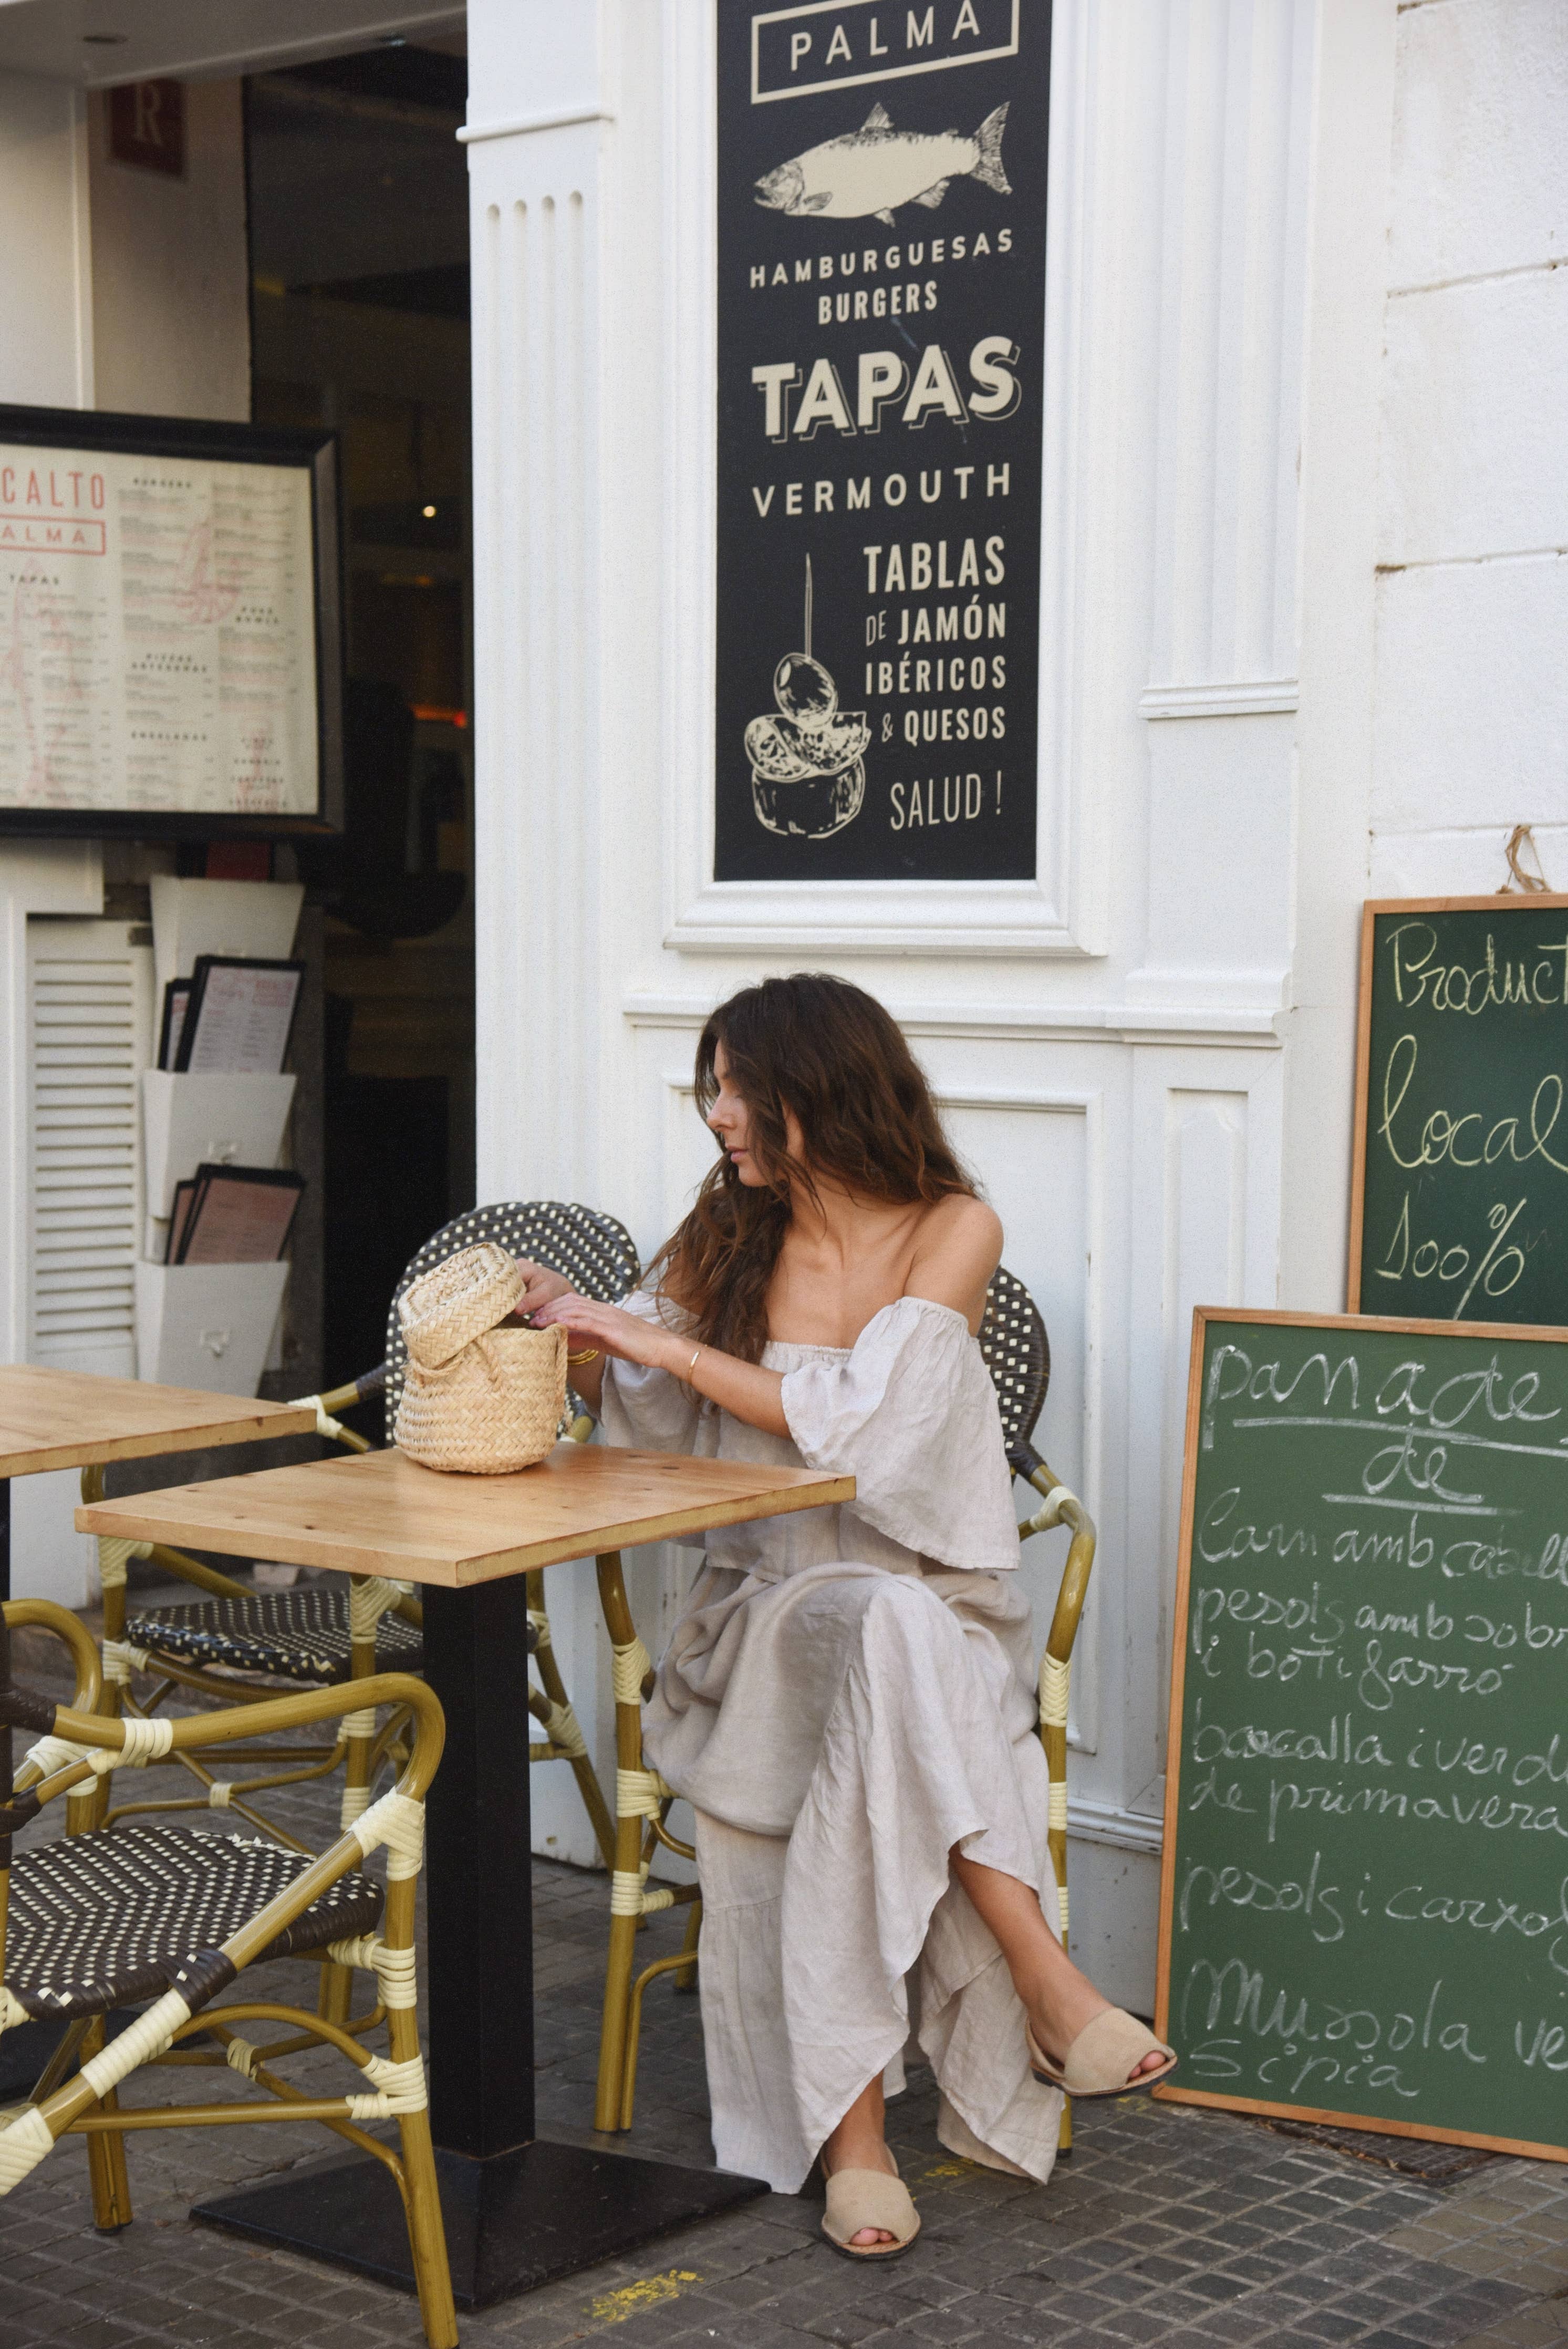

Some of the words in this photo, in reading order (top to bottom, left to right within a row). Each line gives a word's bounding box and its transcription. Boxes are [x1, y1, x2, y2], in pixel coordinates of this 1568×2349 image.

[791, 0, 982, 71] PALMA
[750, 228, 1012, 288] HAMBURGUESAS
[818, 276, 937, 325] BURGERS
[751, 334, 1021, 444] TAPAS
[2, 466, 105, 510] CALTO
[752, 463, 1010, 517] VERMOUTH
[863, 535, 1005, 594] TABLAS
[866, 610, 886, 647] DE
[897, 594, 1006, 645] JAMÓN
[866, 651, 1006, 695] IBÉRICOS
[881, 713, 893, 742] &
[904, 706, 1005, 746] QUESOS
[890, 773, 981, 830] SALUD
[1202, 1345, 1568, 1451] panade
[1362, 1421, 1484, 1503] de
[1333, 1513, 1435, 1568] amb
[1436, 1734, 1568, 1786] verd
